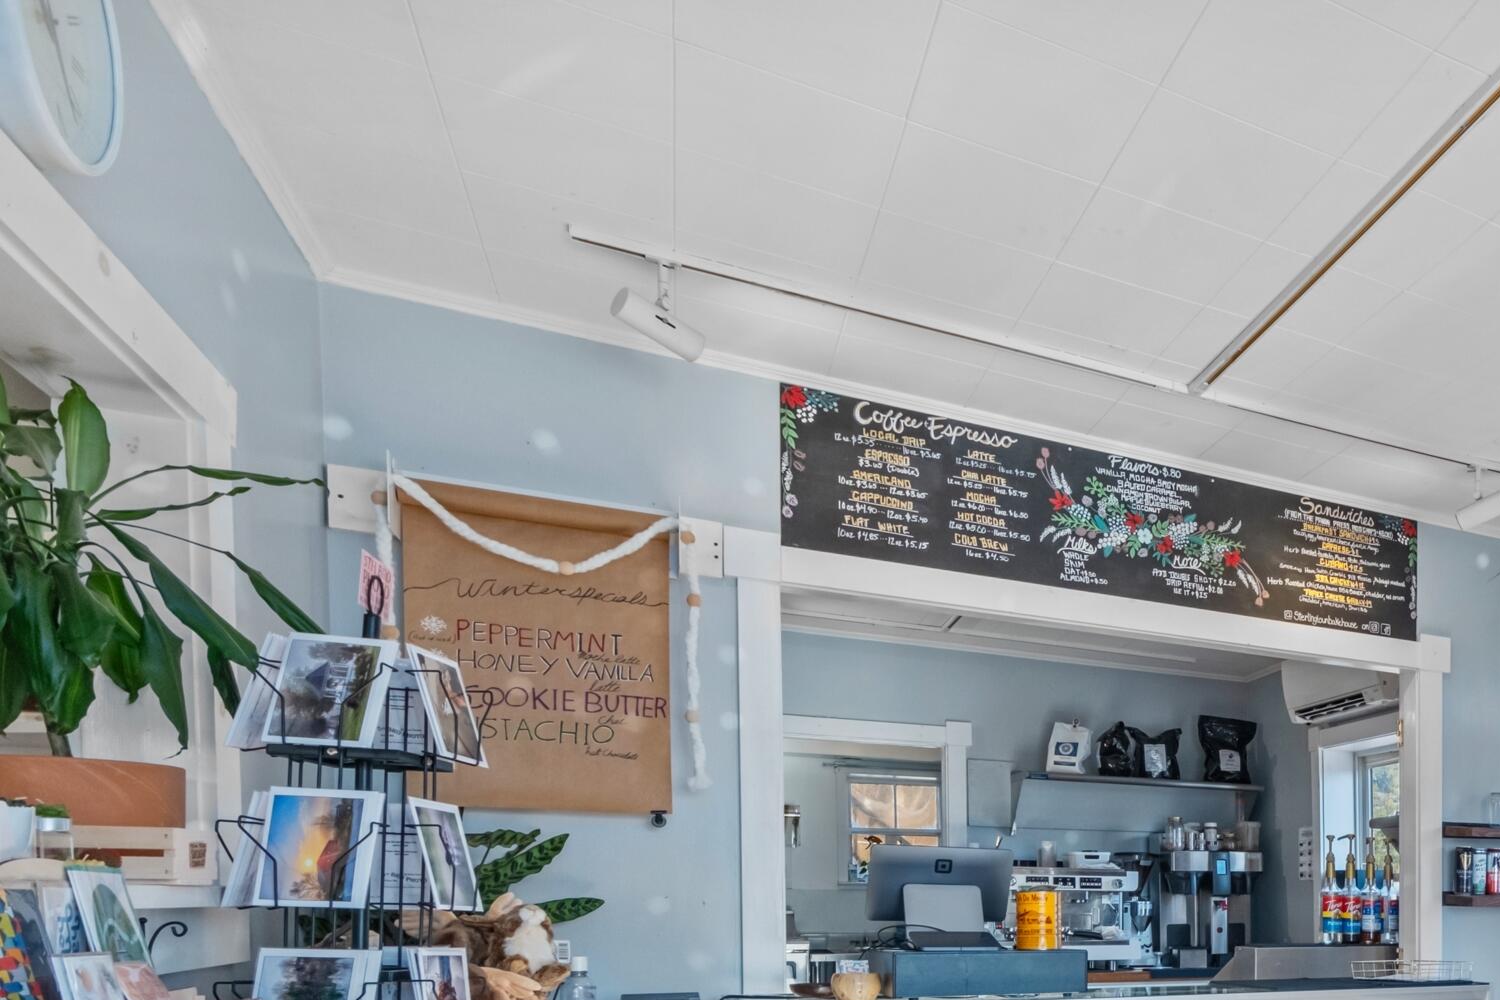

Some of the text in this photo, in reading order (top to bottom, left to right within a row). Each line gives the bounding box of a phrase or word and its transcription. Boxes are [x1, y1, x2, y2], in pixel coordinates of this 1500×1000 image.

[854, 401, 1018, 448] Coffee Espresso
[863, 428, 926, 447] LOCAL DRIP
[864, 449, 910, 467] ESPRESSO
[967, 449, 996, 462] LATTE
[853, 469, 912, 489] AMERICANO
[961, 469, 1006, 486] CHAI LATTE
[852, 491, 913, 510] CAPPUCCINO
[966, 491, 997, 505] MOCHA
[957, 511, 1006, 527] HOT COCOA
[1299, 496, 1375, 527] Sandwiches
[844, 514, 910, 534] FLAT WHITE
[905, 539, 929, 549] $5.15
[954, 533, 1008, 552] COLD BREW
[1063, 535, 1097, 554] Milks
[1062, 550, 1089, 561] WHOLE
[1064, 558, 1085, 569] SKIM
[1173, 554, 1201, 569] More
[1165, 578, 1182, 587] DRIP
[1267, 577, 1283, 585] Herb
[456, 618, 623, 656] PEPPERMINT
[456, 648, 655, 682] HONEY VANILLA
[466, 685, 667, 719] COOKIE BUTTER
